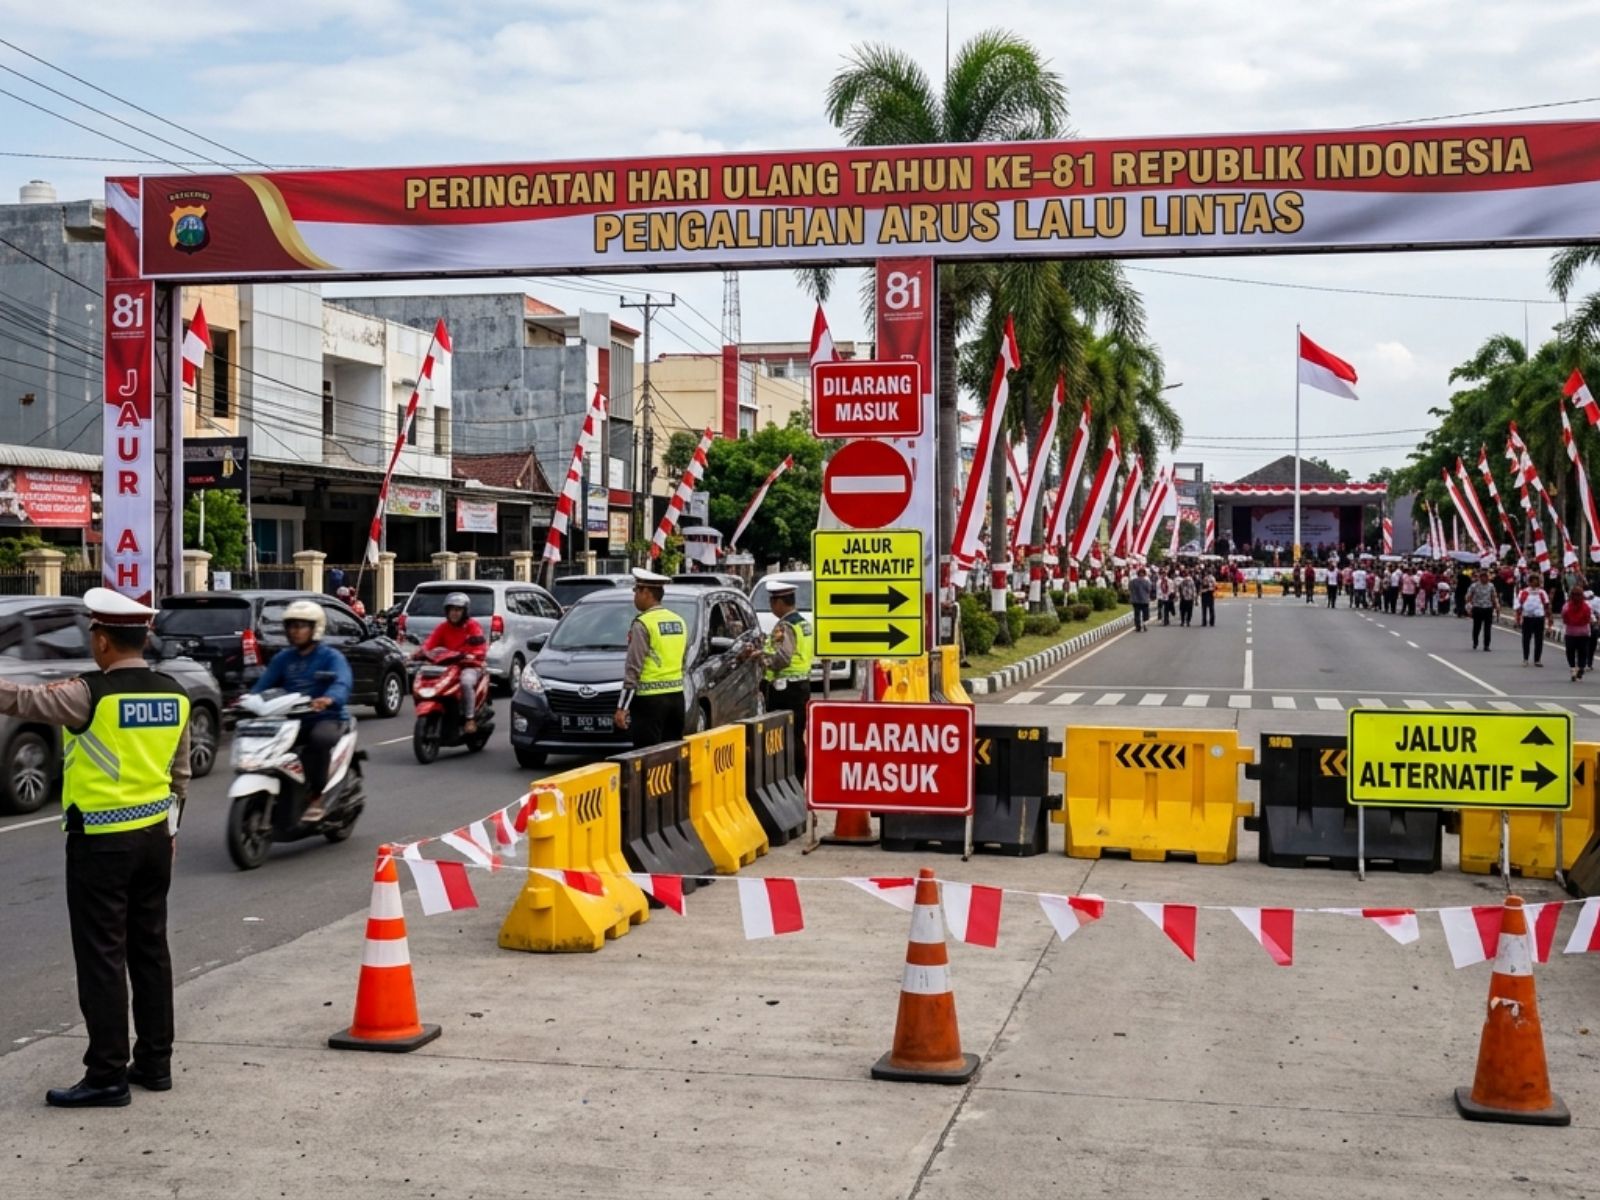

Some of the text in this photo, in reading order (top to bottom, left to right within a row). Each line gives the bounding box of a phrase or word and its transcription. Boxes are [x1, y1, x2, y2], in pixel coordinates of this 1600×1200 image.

[405, 169, 616, 210] PERINGATAN
[627, 166, 710, 202] HARI
[722, 161, 839, 198] ULANG
[850, 156, 973, 195] TAHUN
[1112, 145, 1304, 187] REPUBLIK
[1315, 136, 1532, 179] INDONESIA
[594, 191, 1304, 253] PENGALIHAN ARUS LALU LINTAS
[885, 270, 921, 310] 81
[112, 292, 145, 328] 81
[823, 375, 912, 397] DILARANG
[835, 402, 900, 422] MASUK
[842, 538, 893, 555] JALUR
[821, 558, 915, 575] ALTERNATIF
[123, 702, 178, 723] POLISI
[820, 721, 961, 754] DILARANG
[1395, 725, 1477, 753] JALUR
[840, 761, 940, 793] MASUK
[1359, 761, 1513, 791] ALTERNATIF
